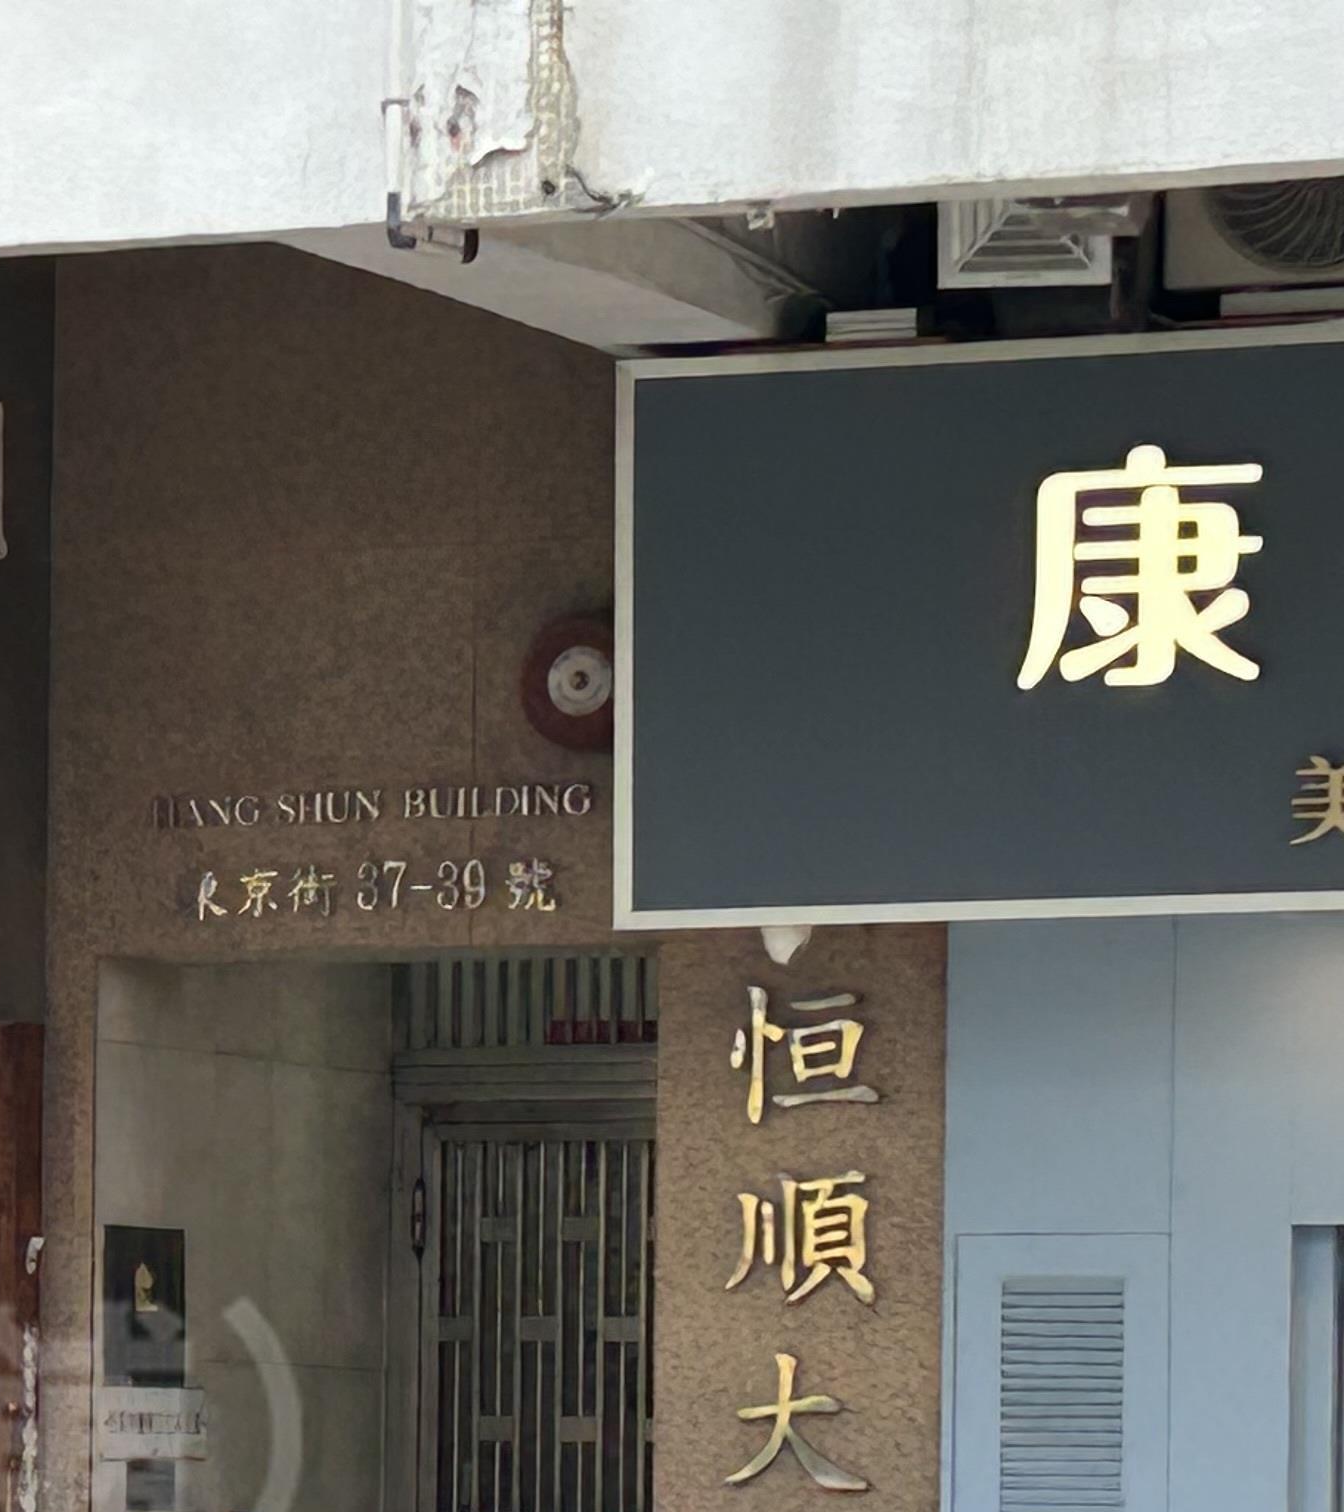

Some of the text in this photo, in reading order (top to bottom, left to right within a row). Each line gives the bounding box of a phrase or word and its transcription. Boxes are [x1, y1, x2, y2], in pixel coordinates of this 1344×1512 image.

[1015, 443, 1265, 691] 康
[276, 788, 382, 825] SHUN
[403, 783, 593, 819] BUILDING
